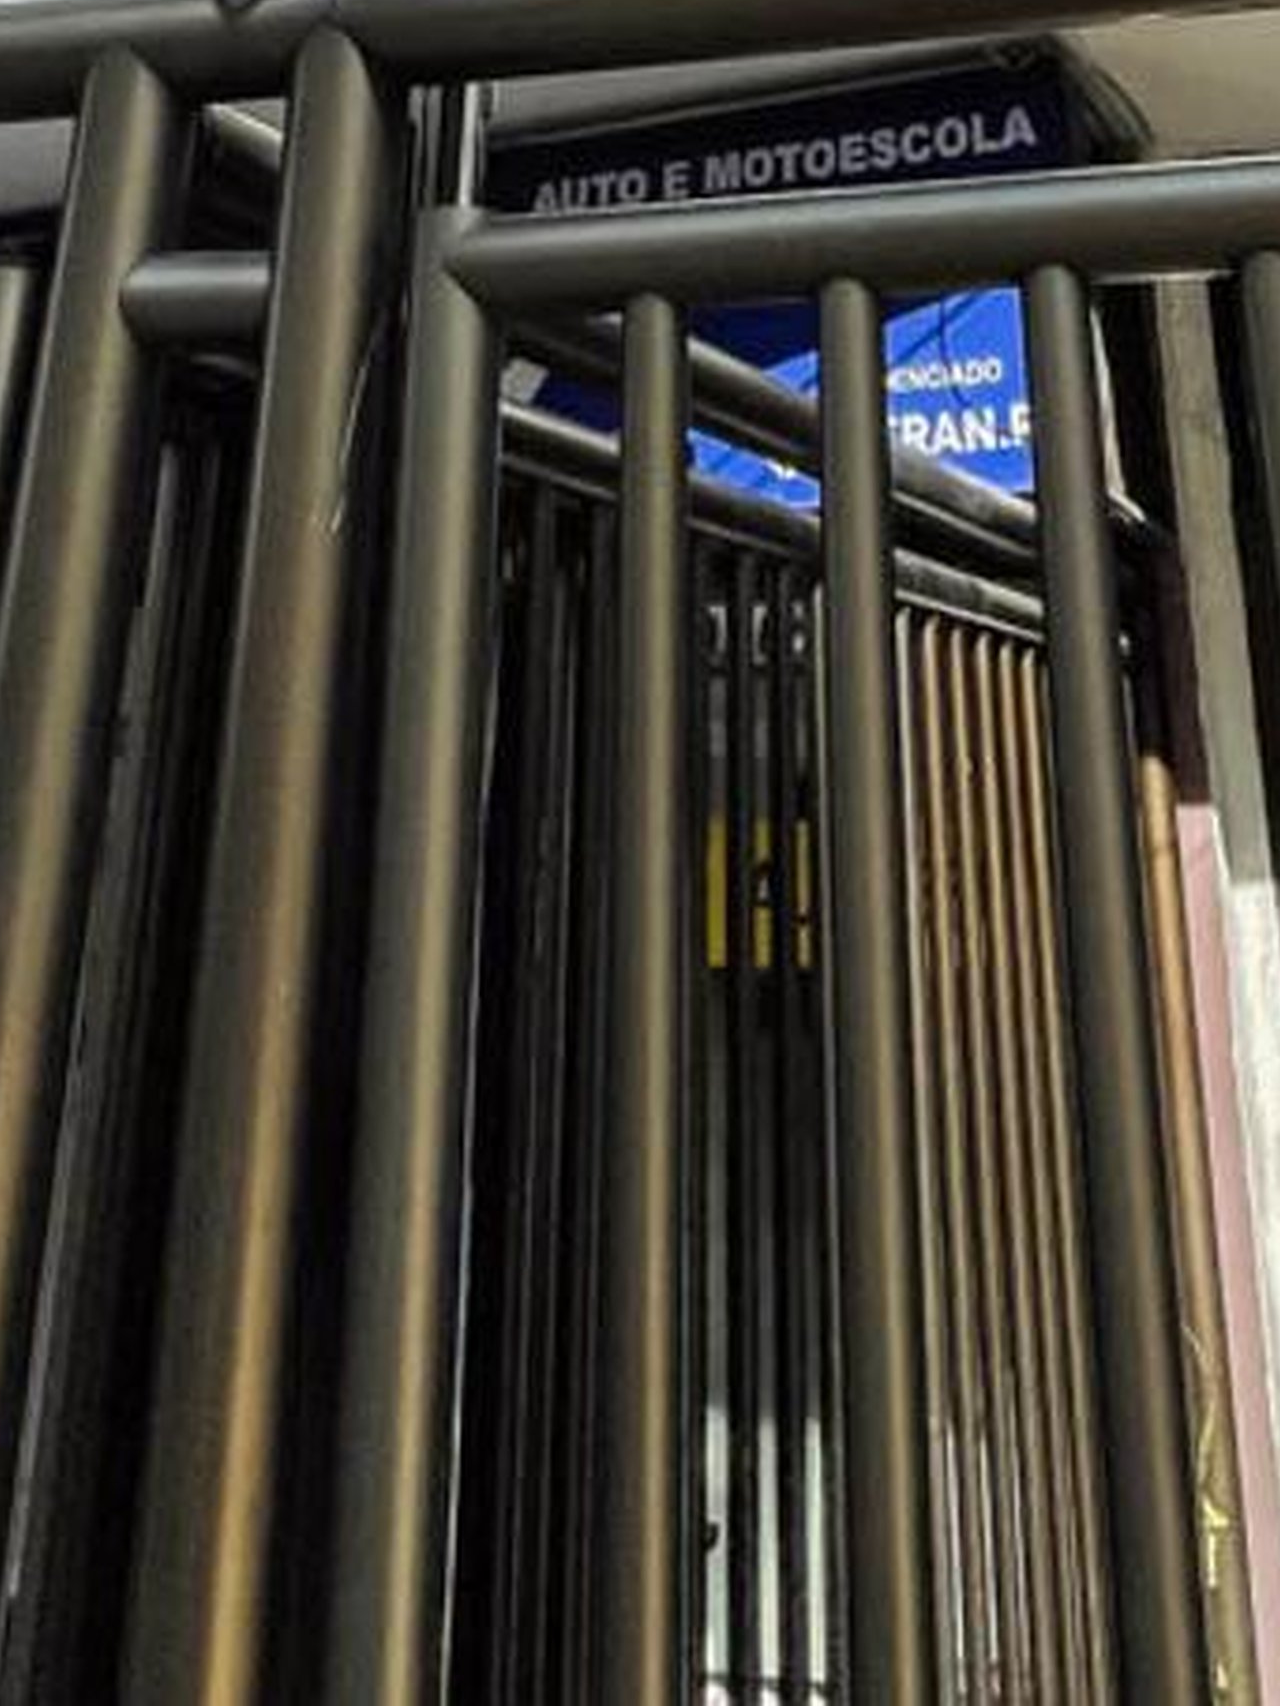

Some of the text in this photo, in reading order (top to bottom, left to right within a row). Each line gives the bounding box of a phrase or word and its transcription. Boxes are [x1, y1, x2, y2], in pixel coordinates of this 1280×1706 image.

[533, 106, 1038, 219] AUTO E MOTOESCOLA
